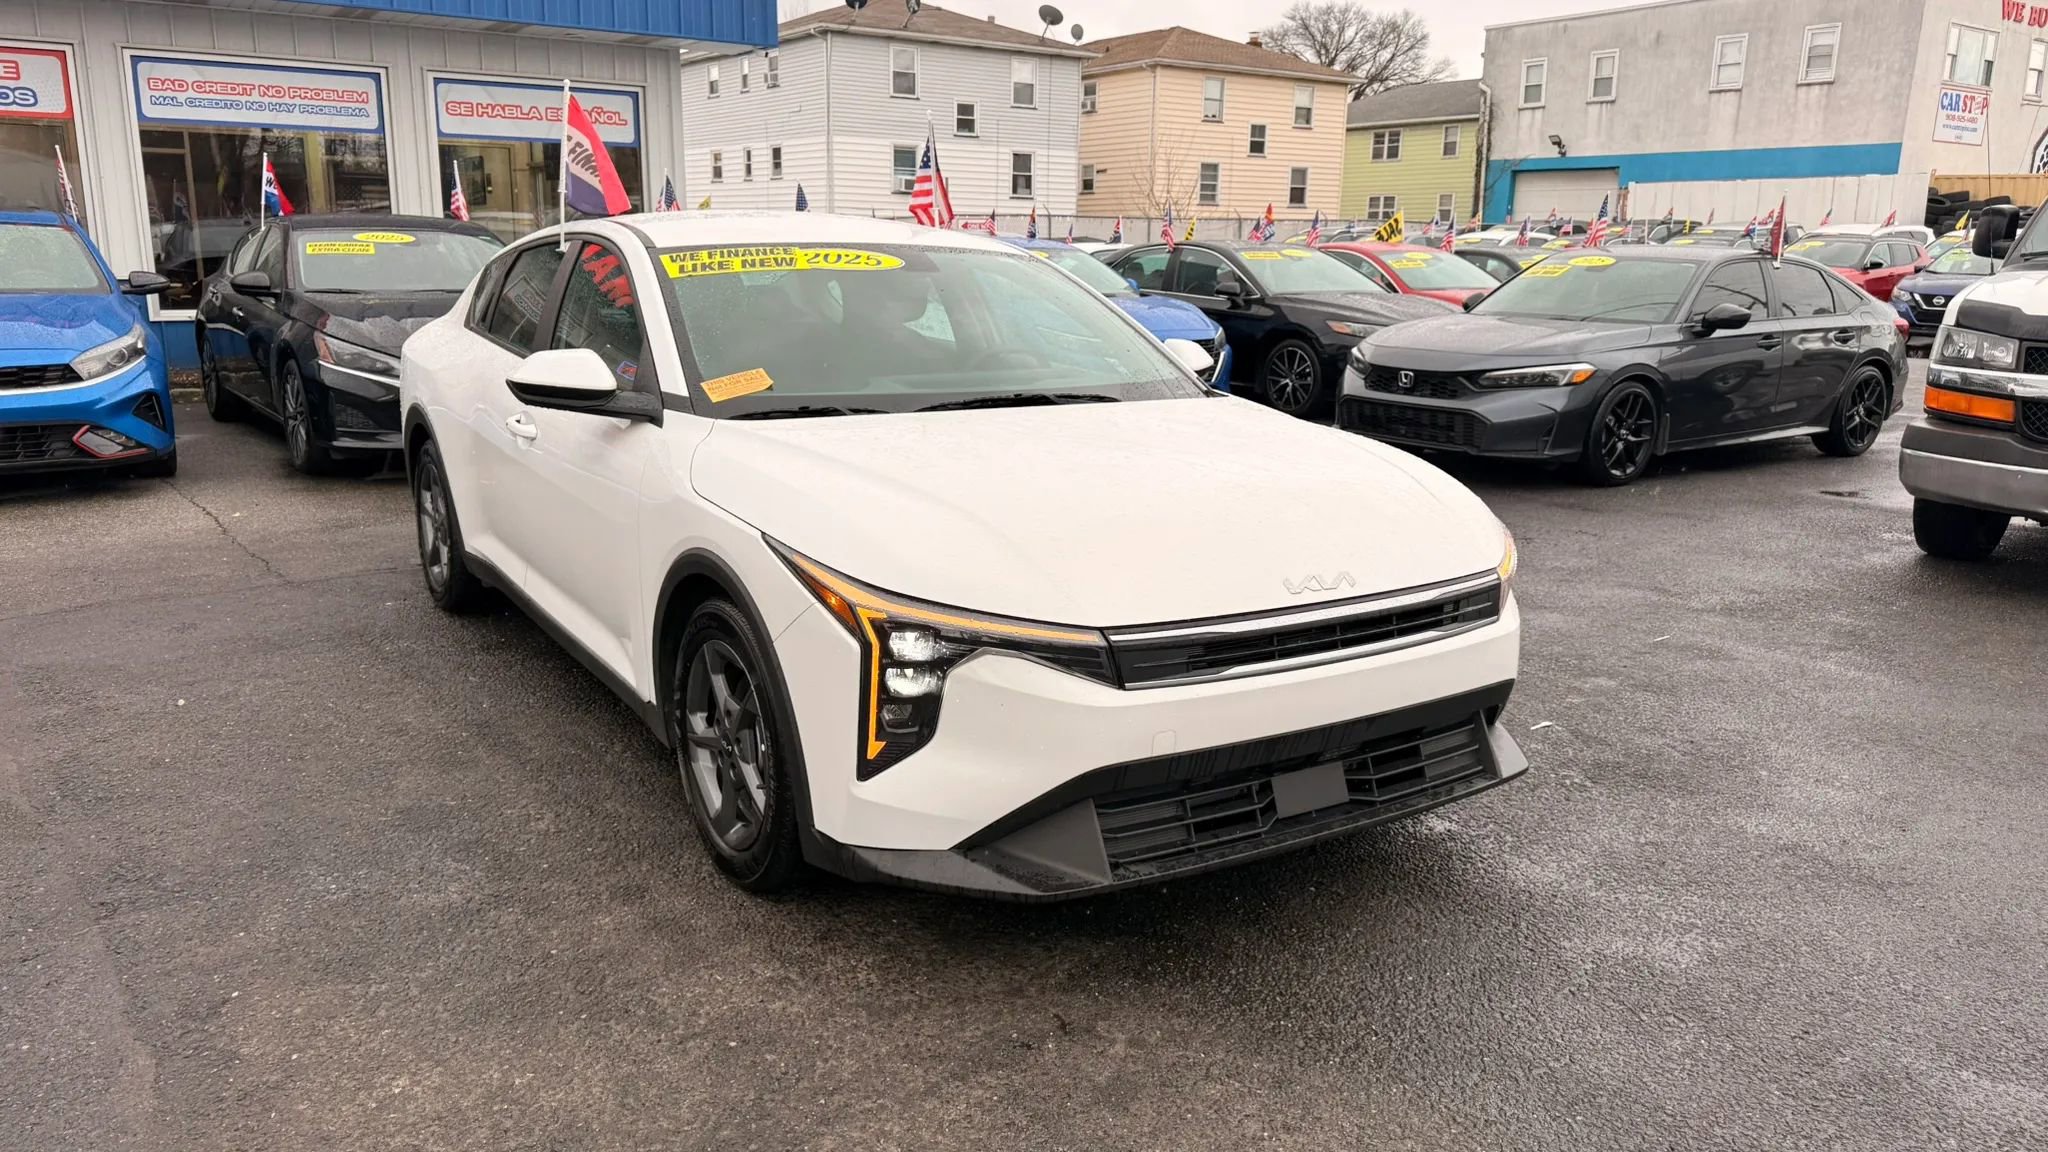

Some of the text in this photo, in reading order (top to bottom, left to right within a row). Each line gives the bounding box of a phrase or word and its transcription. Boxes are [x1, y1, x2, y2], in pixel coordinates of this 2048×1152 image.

[2002, 0, 2026, 23] WE
[148, 77, 369, 103] BAD CREDIT NO PROBLEM
[151, 95, 369, 117] MAL CREDITO NO HAY PROBLEMA
[1940, 92, 1961, 112] CAR
[446, 101, 628, 126] SE HABLA ESÑOL
[669, 248, 797, 264] WE FINANCE
[678, 256, 798, 275] LIKE NEW
[804, 252, 882, 267] 2025
